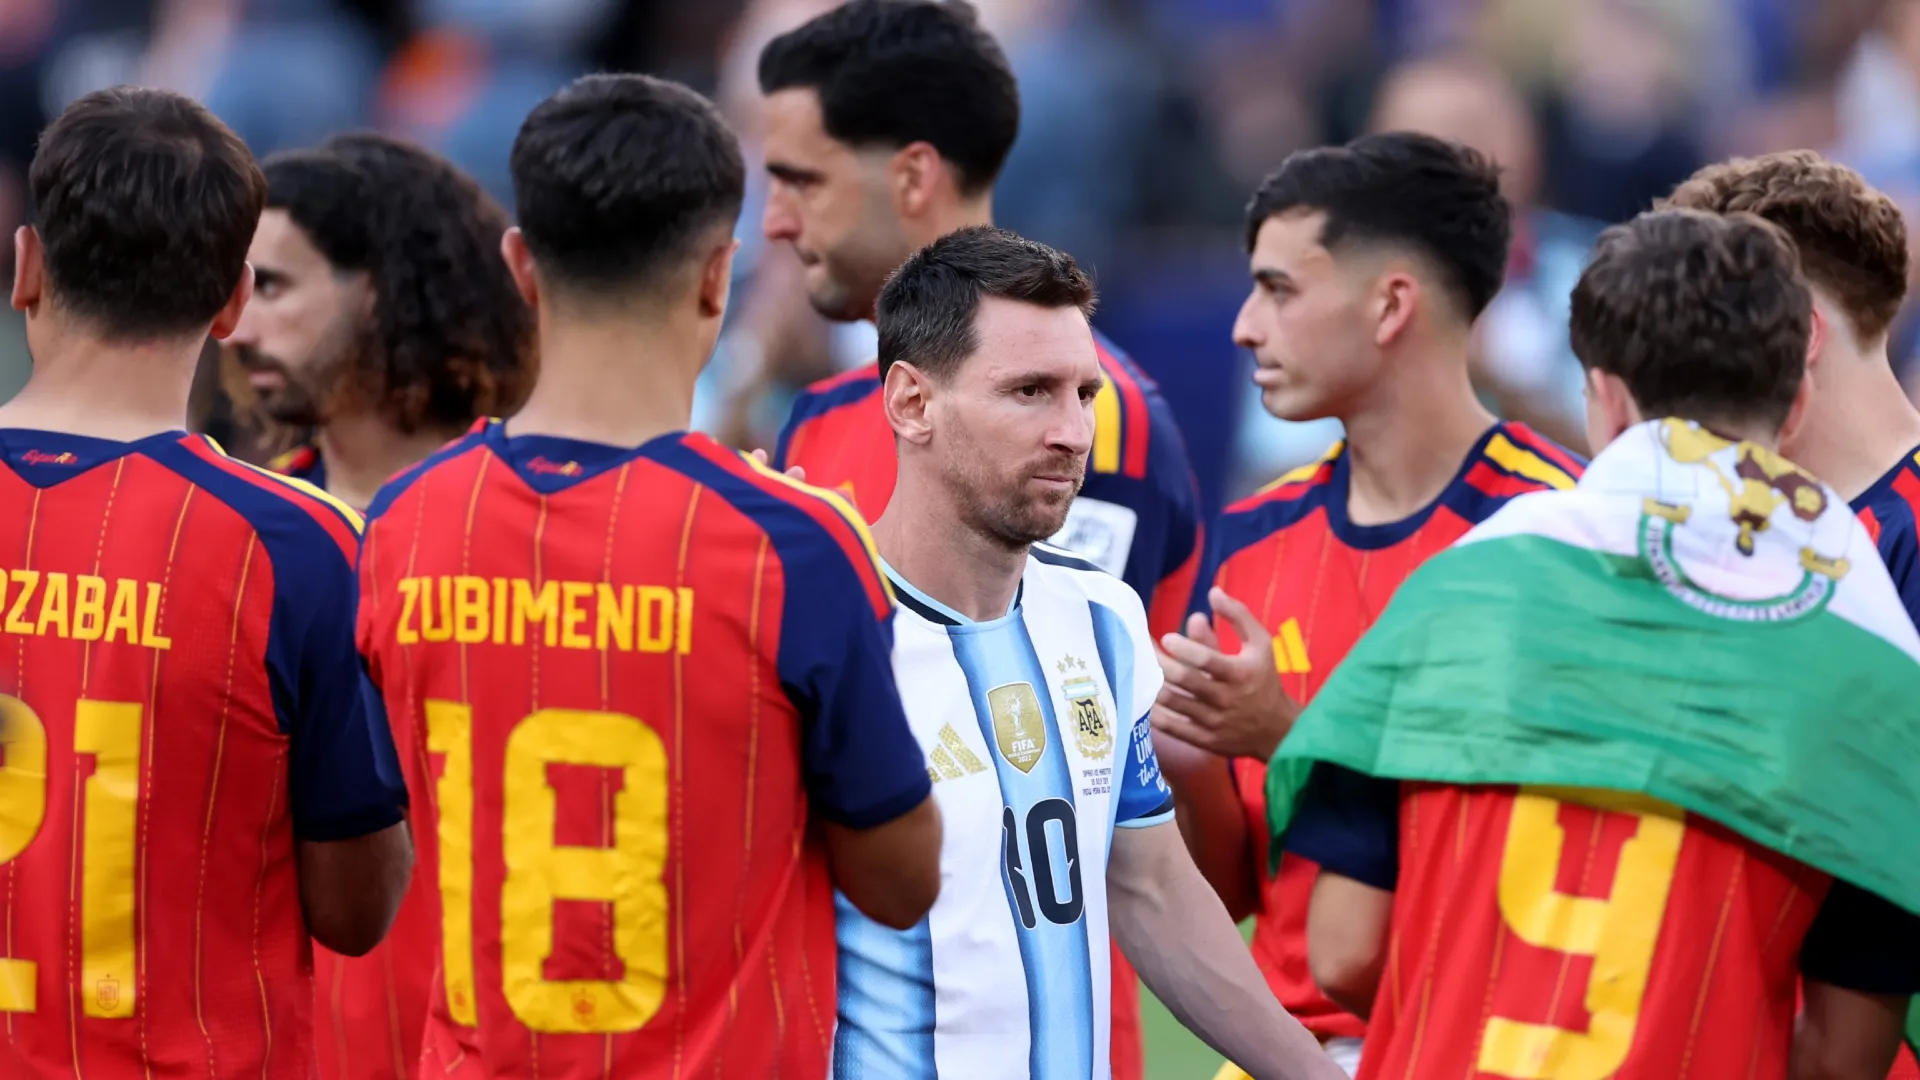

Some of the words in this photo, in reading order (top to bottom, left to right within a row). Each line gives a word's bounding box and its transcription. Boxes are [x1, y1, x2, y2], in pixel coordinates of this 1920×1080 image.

[0, 568, 171, 649] ZABAL
[397, 575, 694, 655] ZUBIMENDI
[1011, 738, 1035, 752] FIFA
[1132, 716, 1151, 743] FOO
[424, 698, 668, 1034] 18
[1002, 797, 1084, 930] 10
[1477, 784, 1686, 1080] 9
